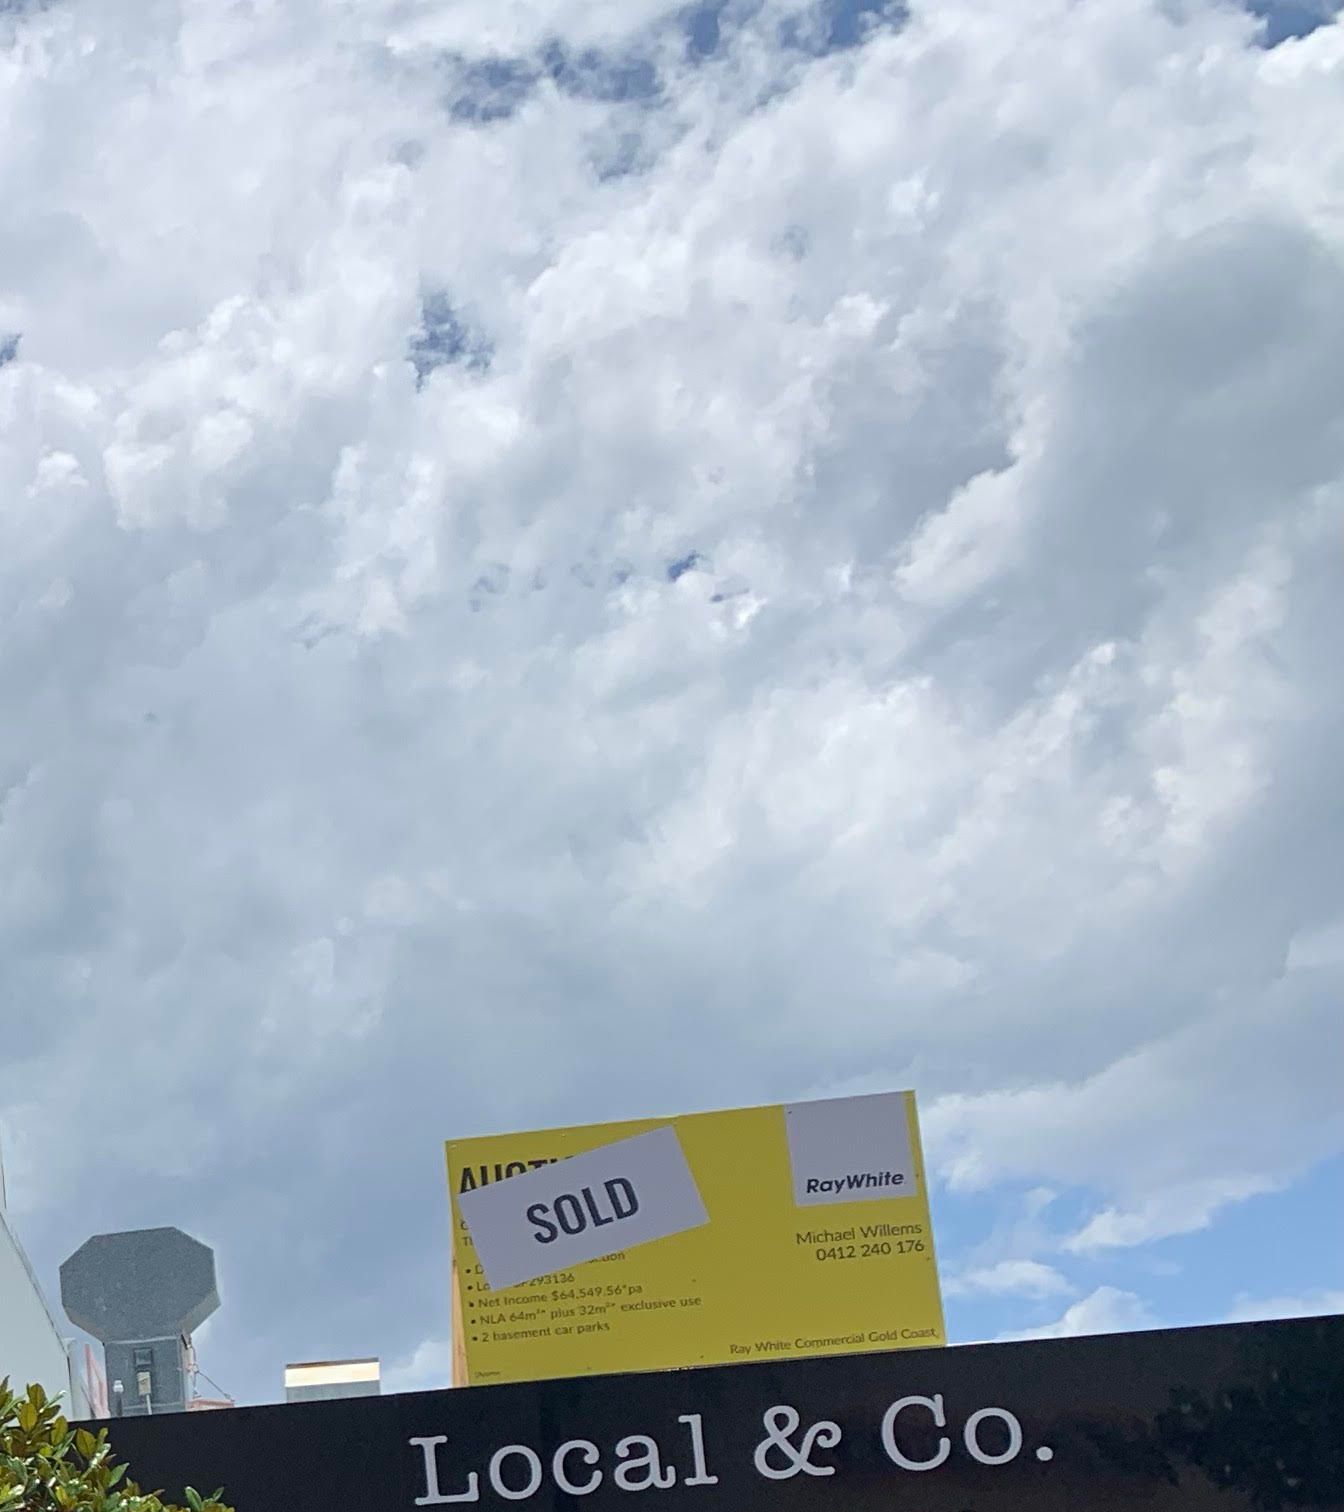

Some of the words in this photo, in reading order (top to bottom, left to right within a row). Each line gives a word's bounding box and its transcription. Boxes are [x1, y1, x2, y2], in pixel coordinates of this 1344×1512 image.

[805, 1171, 905, 1194] RayWhite
[526, 1177, 639, 1244] SOLD
[796, 1227, 856, 1245] Michael
[859, 1223, 923, 1239] Willems
[816, 1245, 857, 1261] 0412
[860, 1242, 892, 1258] 240
[896, 1239, 925, 1254] 176
[478, 1297, 501, 1308] Net
[504, 1294, 548, 1306] Income
[479, 1313, 506, 1325] NLA
[550, 1307, 576, 1321] plus
[620, 1299, 677, 1313] exclusive
[679, 1296, 702, 1308] use
[482, 1332, 490, 1342] 2
[492, 1326, 552, 1342] basement
[554, 1325, 574, 1336] car
[576, 1320, 611, 1335] parks
[729, 1344, 752, 1355] Ray
[755, 1341, 792, 1352] White
[794, 1333, 865, 1349] Commercial
[868, 1329, 899, 1343] Gold
[900, 1326, 936, 1340] Coast
[408, 1413, 720, 1507] Local
[752, 1404, 843, 1481] &
[879, 1394, 1055, 1473] Co.
